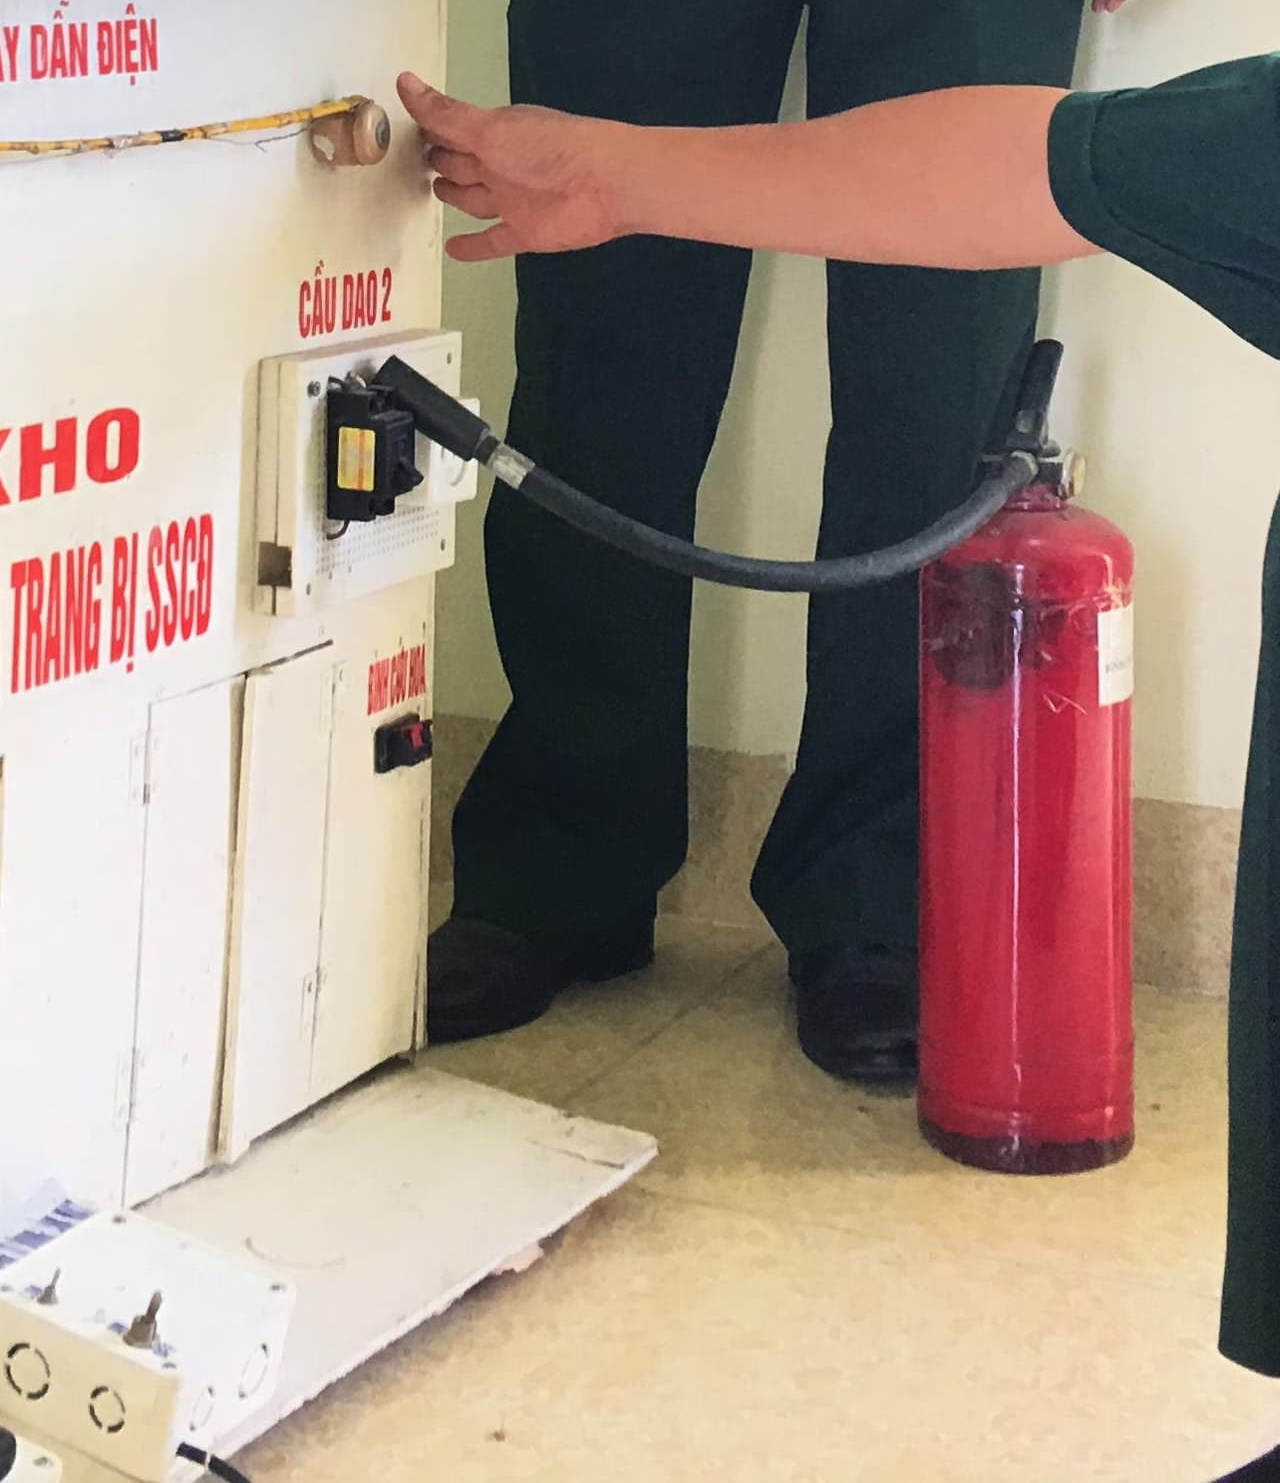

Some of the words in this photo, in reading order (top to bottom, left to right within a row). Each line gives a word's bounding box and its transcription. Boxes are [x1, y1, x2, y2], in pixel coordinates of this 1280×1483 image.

[30, 0, 88, 80] DẪN
[97, 3, 158, 86] ĐIỆN
[299, 259, 337, 339] CẦU
[342, 269, 378, 331] DAO
[381, 267, 393, 322] 2
[10, 541, 102, 694] TRANG
[110, 532, 139, 674] BỊ
[145, 513, 214, 654] SSCĐ
